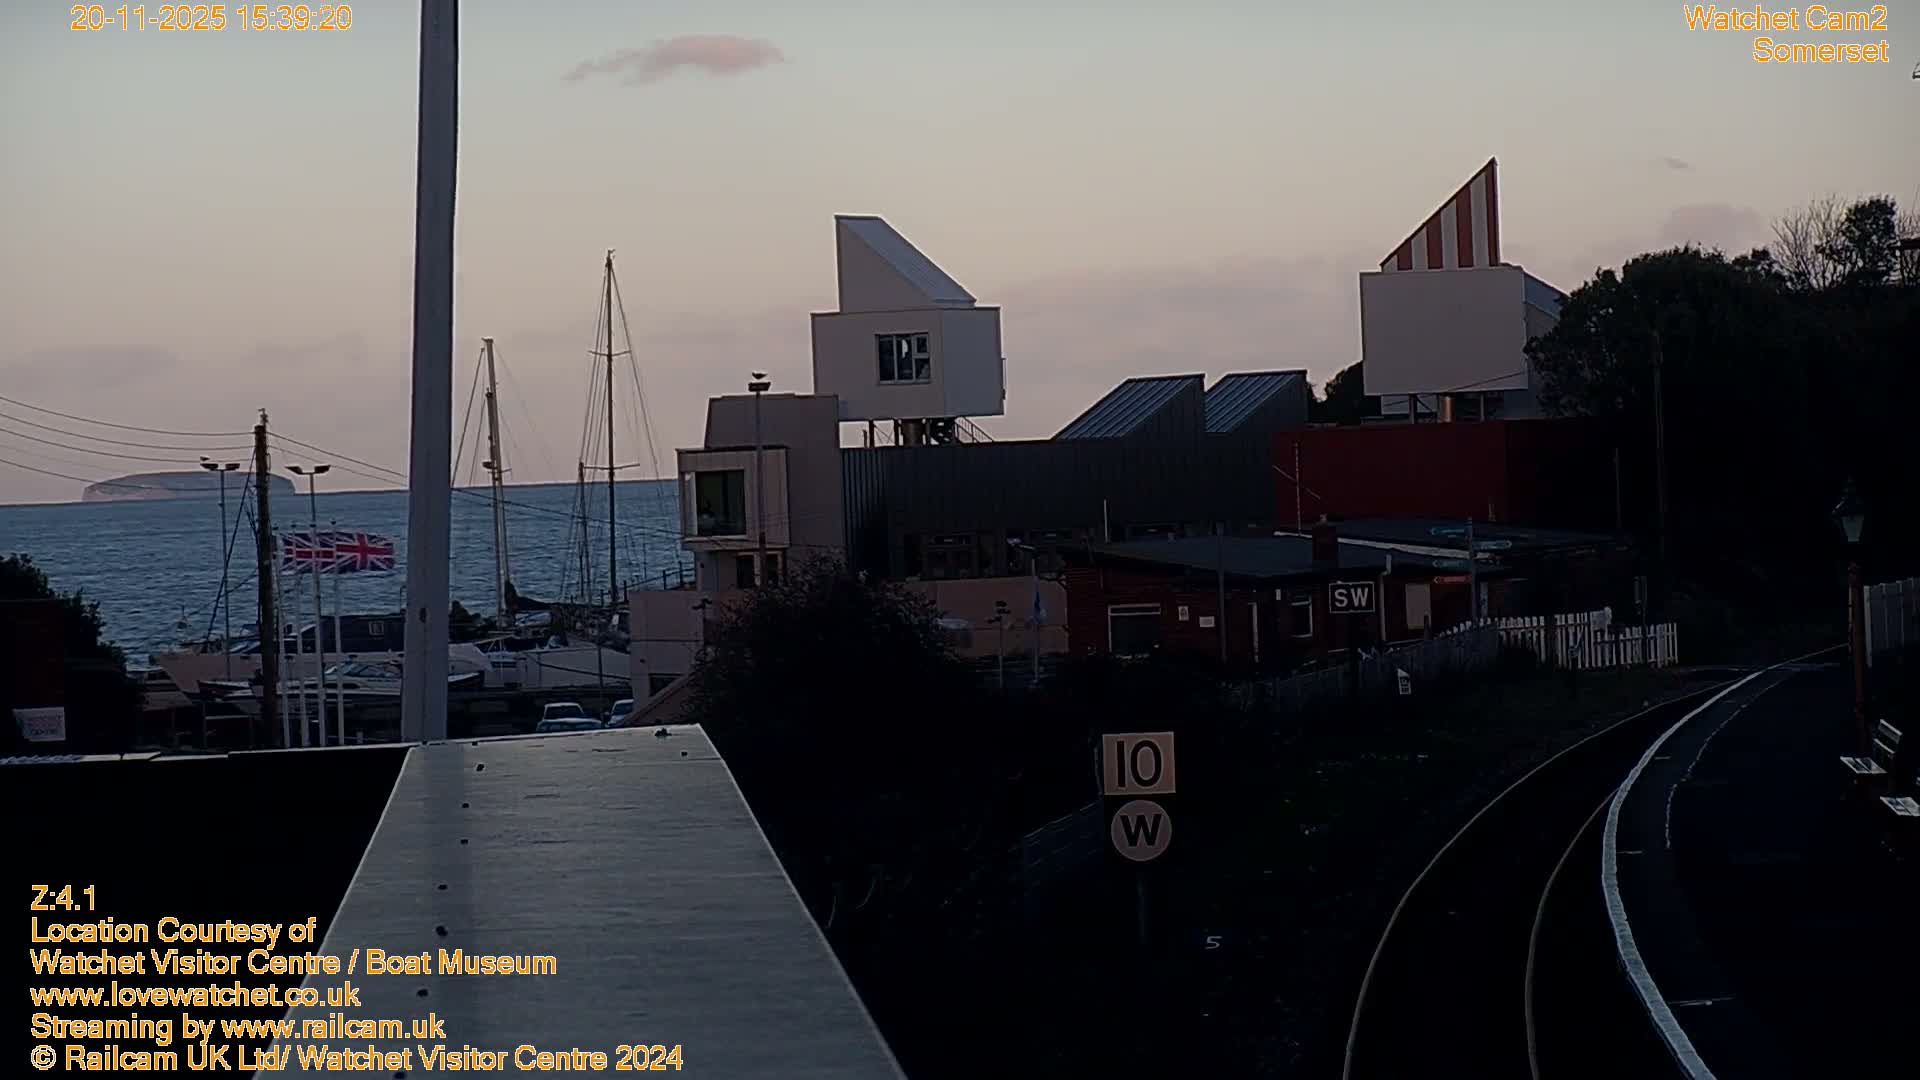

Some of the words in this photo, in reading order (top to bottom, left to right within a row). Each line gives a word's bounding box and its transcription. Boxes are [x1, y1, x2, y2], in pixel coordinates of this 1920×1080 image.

[1334, 587, 1369, 608] SW
[1116, 740, 1162, 788] 10
[1120, 814, 1162, 847] W
